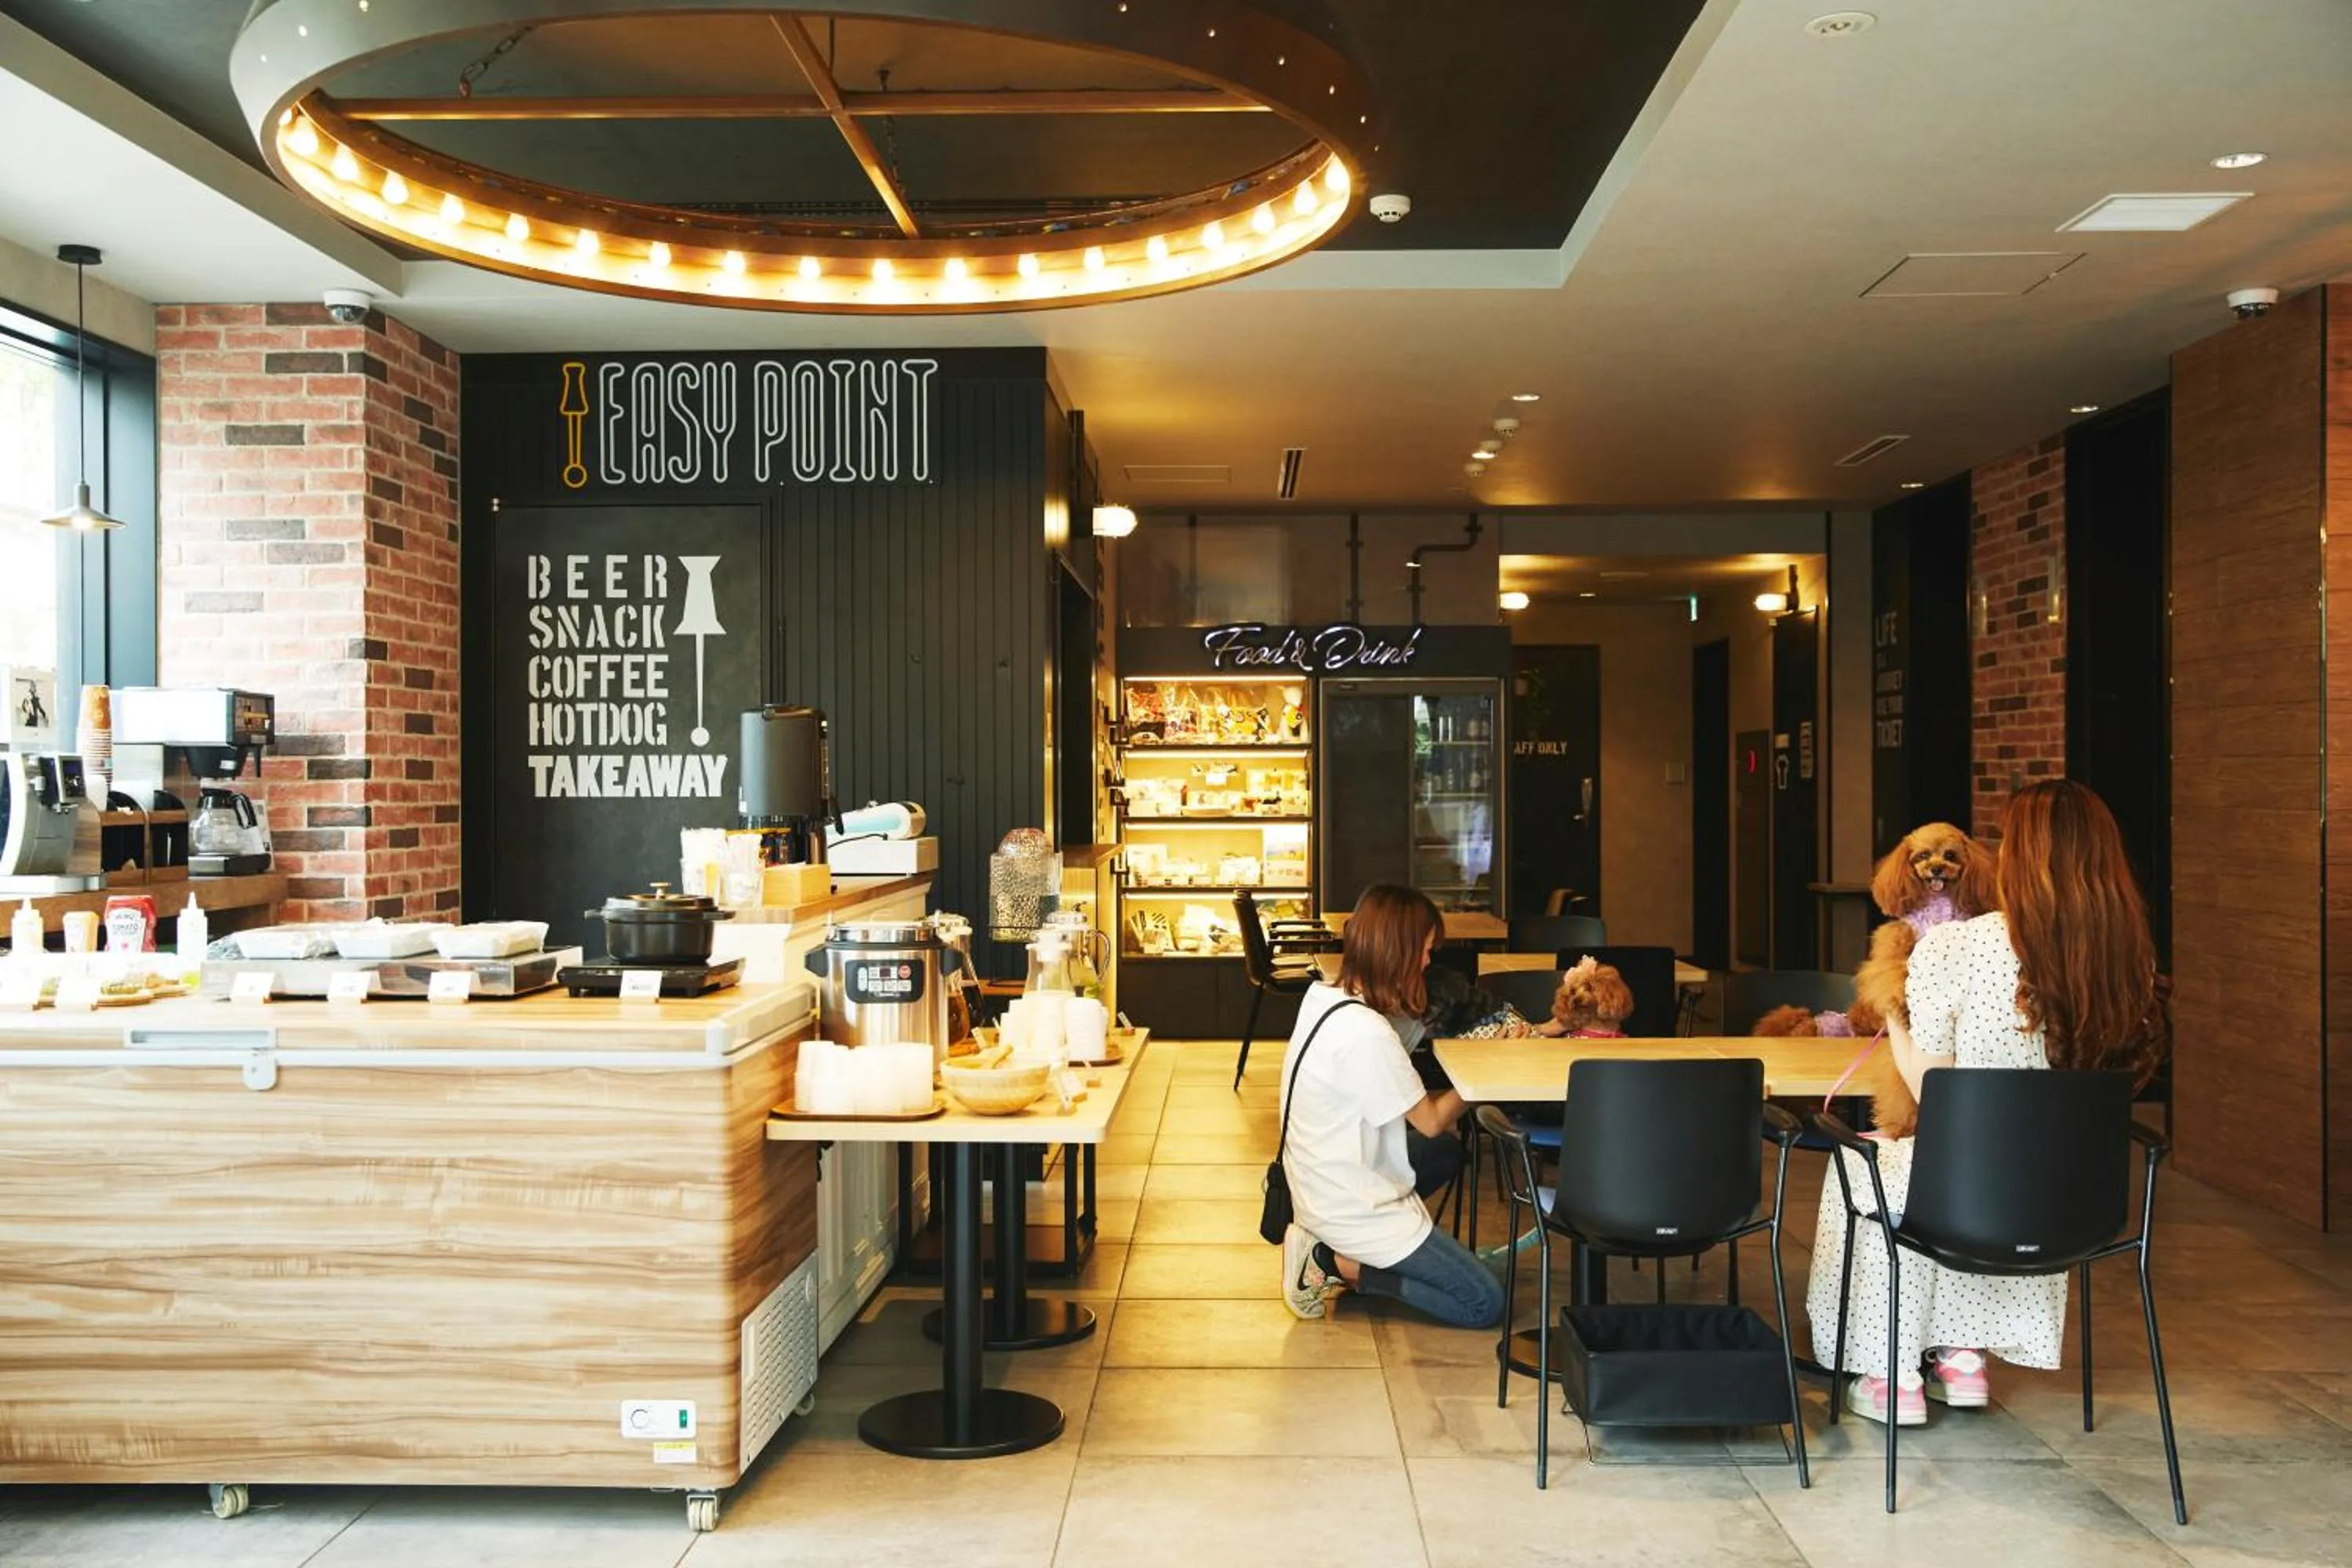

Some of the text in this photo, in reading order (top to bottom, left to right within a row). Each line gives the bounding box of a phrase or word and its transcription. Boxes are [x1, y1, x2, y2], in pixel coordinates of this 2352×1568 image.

[599, 358, 938, 485] EASY POINT
[528, 554, 668, 599] BEER
[528, 604, 666, 649] SNACK
[1205, 626, 1295, 667] Food
[1312, 626, 1422, 670] Drink
[528, 654, 669, 699] COFFEE
[528, 702, 668, 746] HOTDOG
[1514, 741, 1568, 754] AFF ONLY
[528, 754, 728, 798] TAKEAWAY
